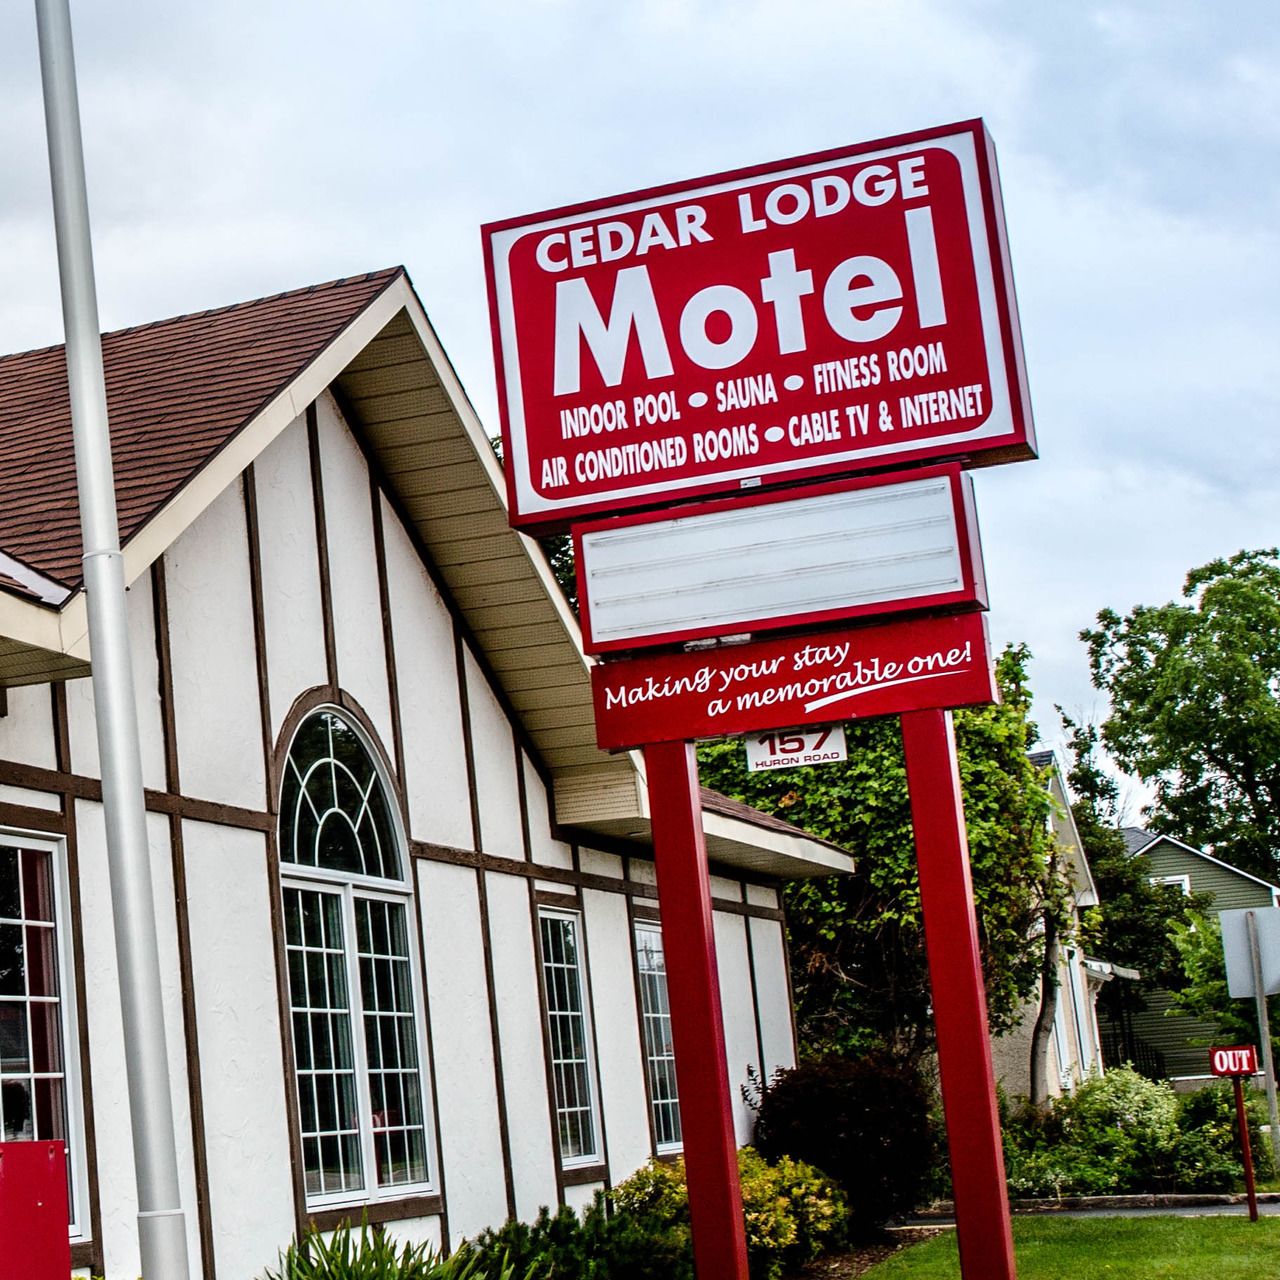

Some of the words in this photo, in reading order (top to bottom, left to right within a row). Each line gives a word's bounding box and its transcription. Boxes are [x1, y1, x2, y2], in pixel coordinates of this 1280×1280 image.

[536, 206, 714, 273] CEDAR
[738, 156, 930, 233] LODGE
[554, 206, 947, 396] Motel
[561, 400, 628, 440] INDOOR
[634, 390, 681, 426] POOL
[716, 373, 779, 413] SAUNA
[813, 354, 882, 395] FITNESS
[887, 341, 948, 382] ROOM
[541, 457, 570, 489] AIR
[575, 437, 688, 482] CONDITIONED
[693, 423, 760, 464] ROOMS
[788, 408, 842, 447] CABLE
[845, 404, 871, 437] TV
[878, 400, 895, 432] &
[899, 384, 984, 429] INTERNET
[605, 665, 718, 710] Making
[718, 654, 786, 693] your
[793, 640, 851, 671] stay
[707, 698, 732, 718] a
[736, 658, 904, 712] memorable
[908, 640, 972, 674] one!
[755, 756, 800, 769] HURON
[803, 751, 840, 764] ROAD
[758, 728, 832, 756] 157
[1214, 1050, 1251, 1072] OUT
